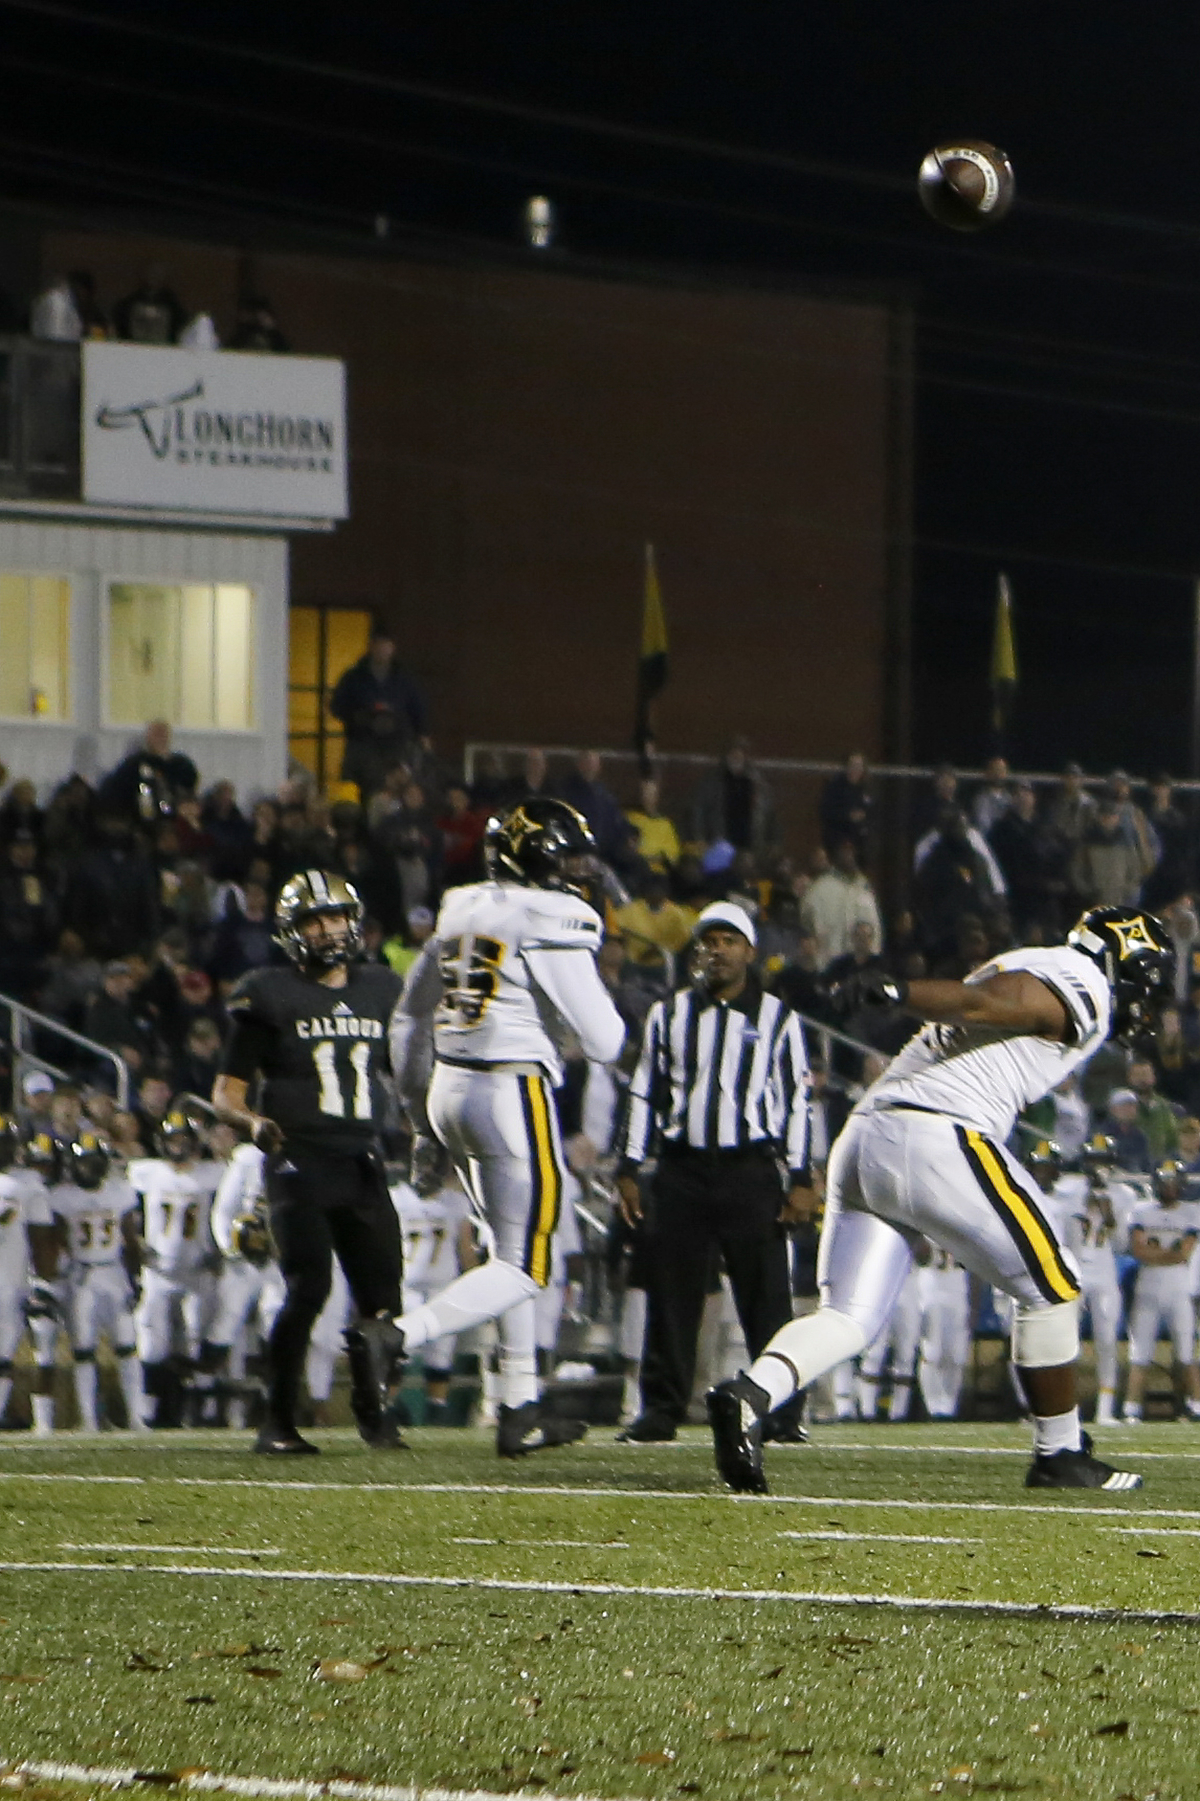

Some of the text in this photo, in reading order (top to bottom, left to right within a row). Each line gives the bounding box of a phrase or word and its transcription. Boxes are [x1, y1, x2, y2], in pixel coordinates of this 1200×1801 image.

[174, 406, 333, 450] LONGHORN
[296, 1016, 383, 1039] CALHOUN
[312, 1040, 372, 1120] 11
